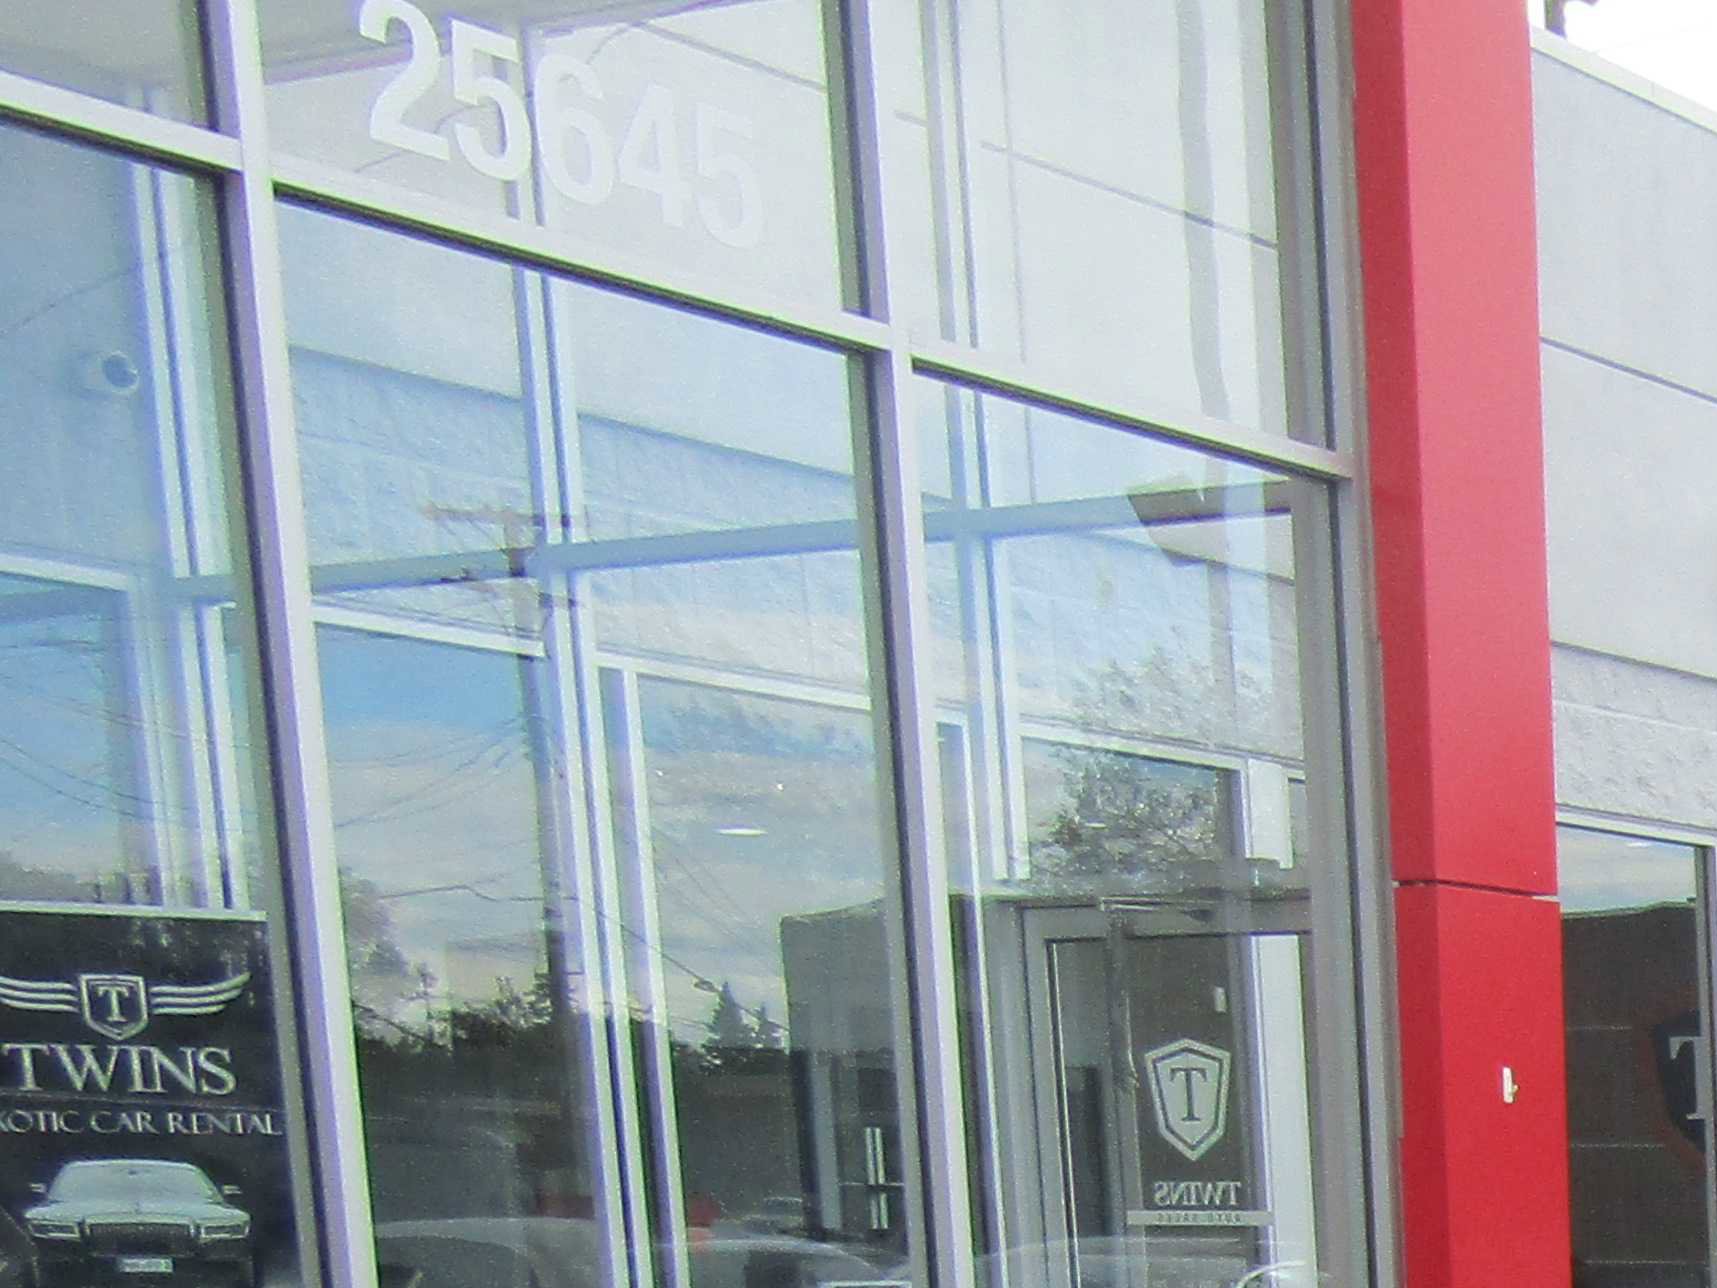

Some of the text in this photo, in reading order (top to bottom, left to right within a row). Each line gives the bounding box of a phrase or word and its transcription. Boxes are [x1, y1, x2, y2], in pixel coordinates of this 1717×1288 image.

[360, 0, 766, 249] 25645
[95, 985, 129, 1022] T
[0, 1043, 237, 1096] TWINS
[1169, 1067, 1208, 1122] T
[0, 1109, 283, 1136] OTIC CAR RENTAL
